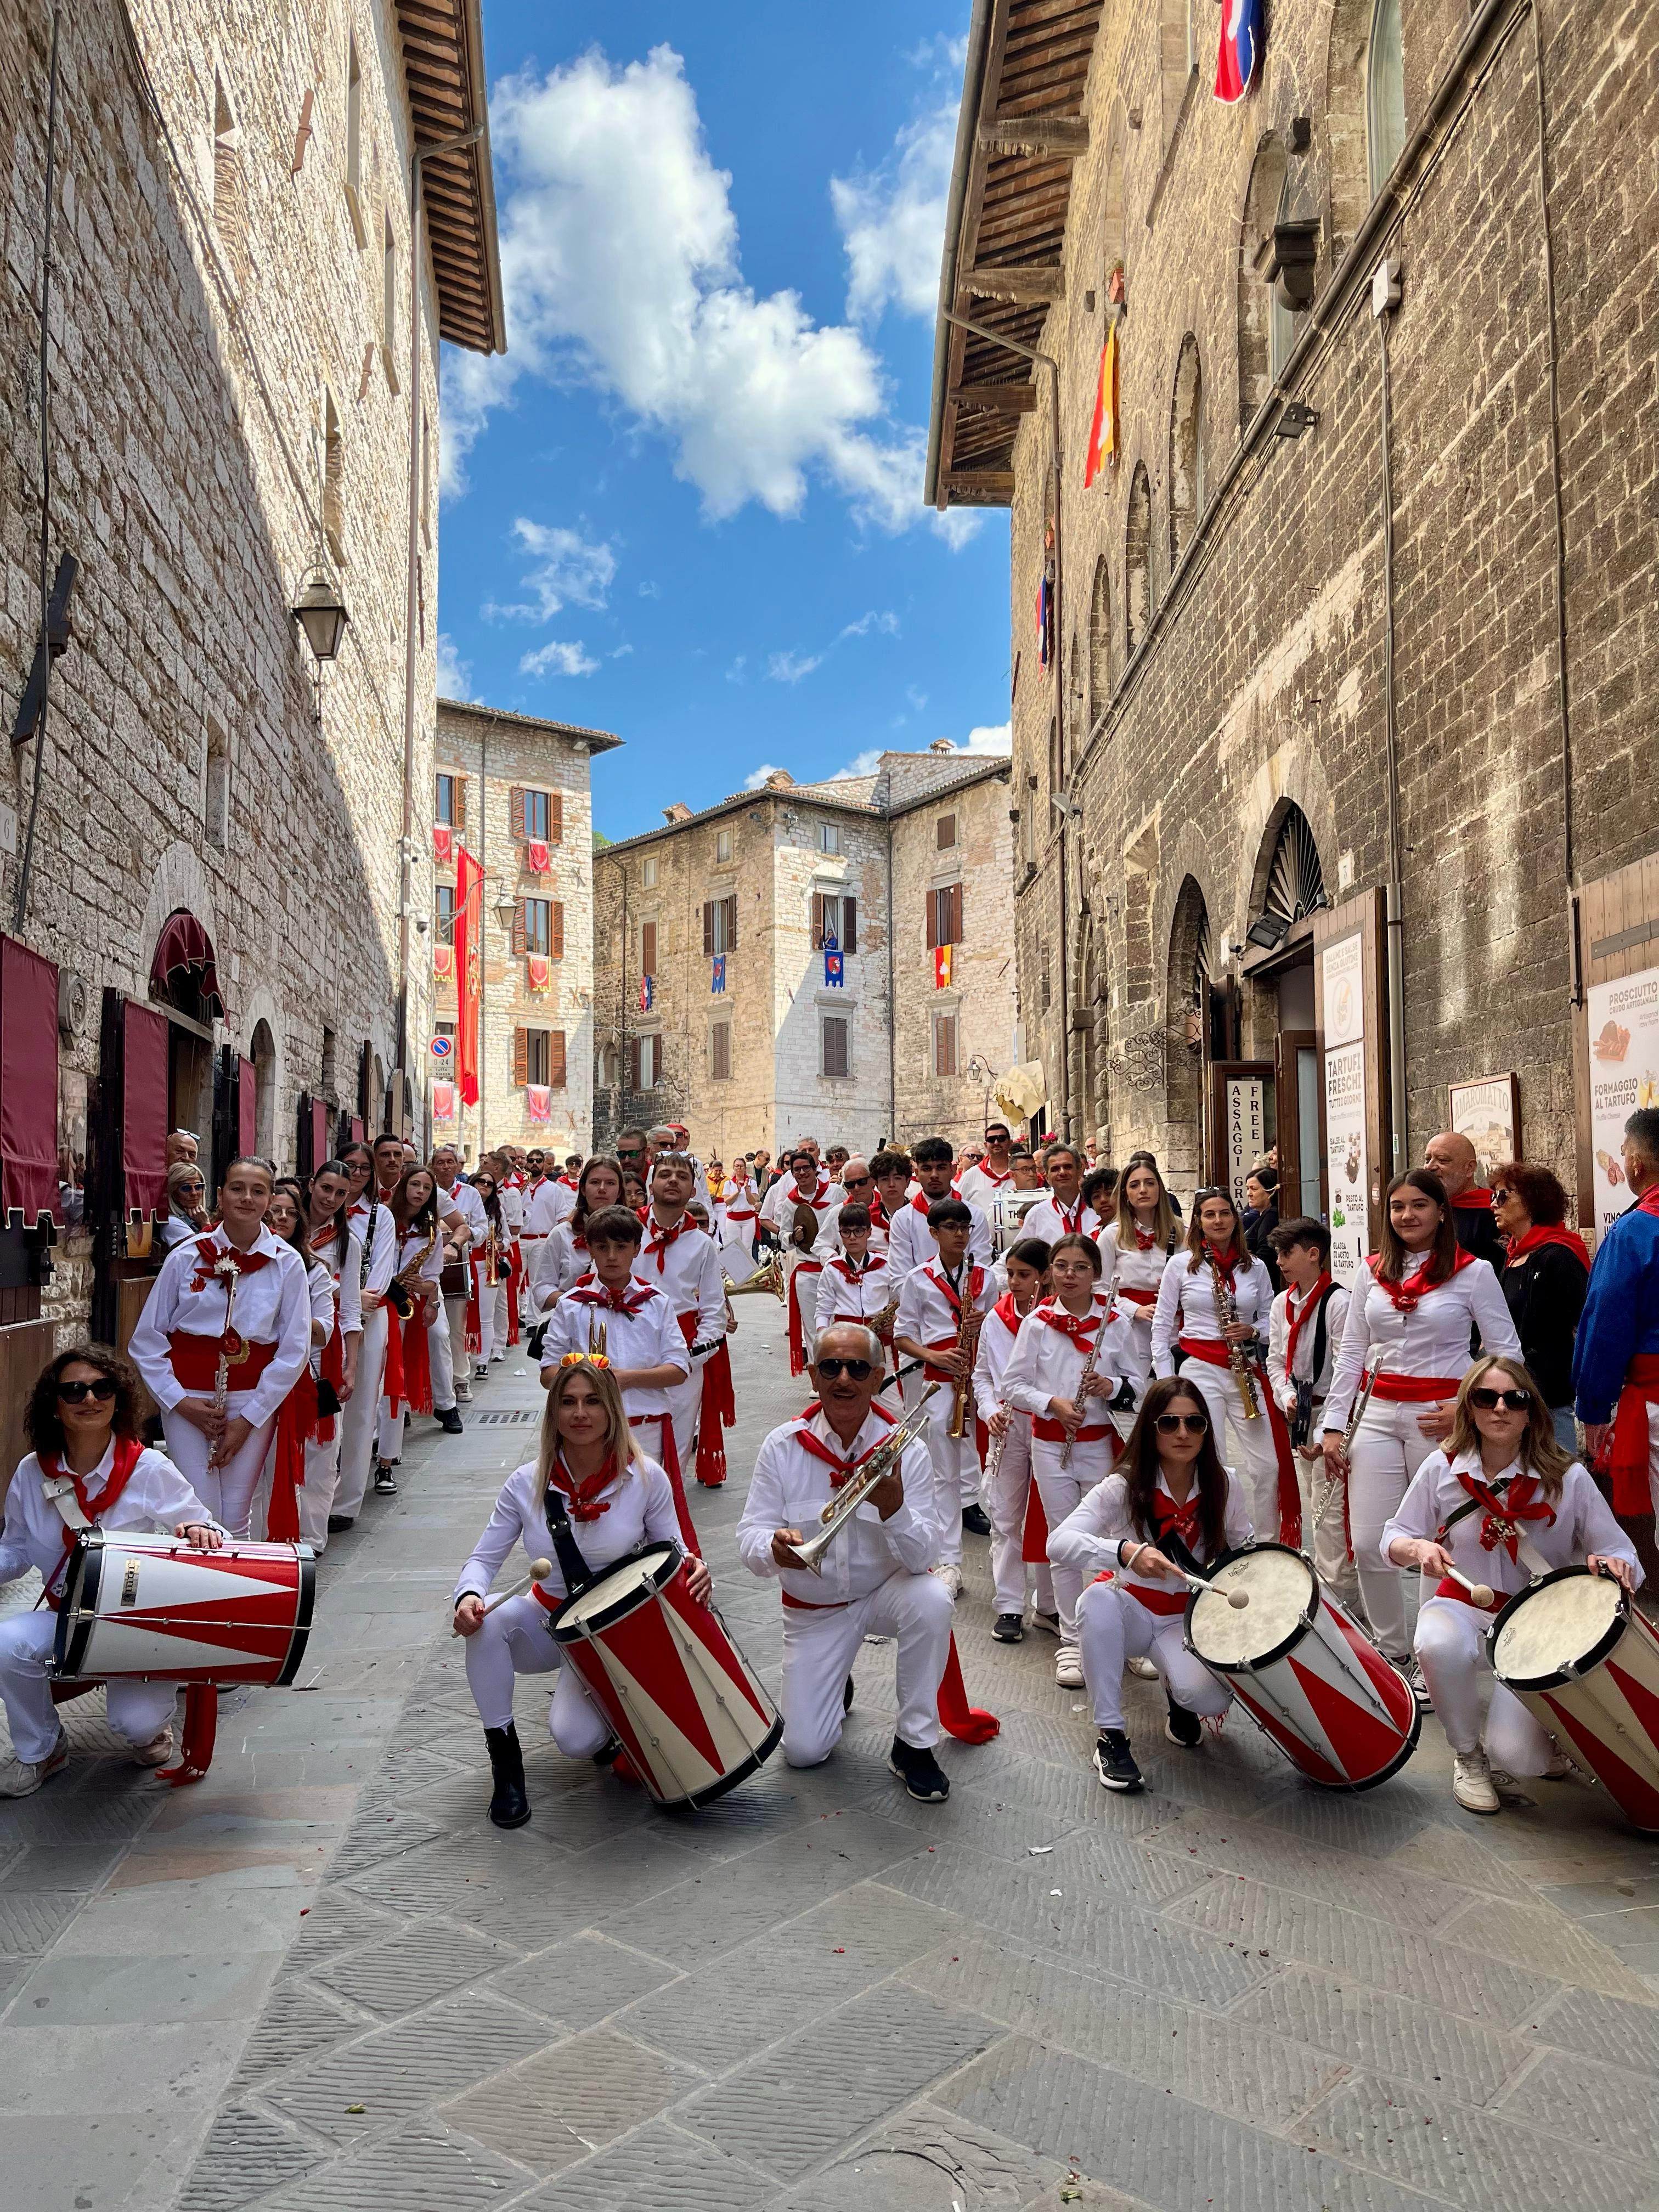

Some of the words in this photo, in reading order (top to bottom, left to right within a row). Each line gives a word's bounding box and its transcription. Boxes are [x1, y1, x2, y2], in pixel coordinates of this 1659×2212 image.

[4, 818, 9, 839] 6
[1609, 981, 1657, 1006] PROSCIUTTO
[1609, 1004, 1626, 1014] CRUDO
[1626, 994, 1658, 1010] ARTIGIANALE
[1328, 1052, 1361, 1078] TARTUFI
[1328, 1072, 1361, 1096] FRESCHI
[1594, 1077, 1638, 1097] FORMAGGIO
[1329, 1097, 1340, 1109] TUTTI
[1344, 1093, 1361, 1106] GIORNI
[1455, 1084, 1509, 1124] AMAROMATTO
[1595, 1098, 1604, 1110] AL
[1604, 1092, 1635, 1108] TARTUFO
[1250, 1086, 1260, 1140] FREE
[1232, 1085, 1243, 1167] ASSAGGI
[1330, 1136, 1340, 1145] SALSE
[1330, 1144, 1345, 1154] TARTUFO
[1346, 1194, 1358, 1203] PESTO
[1358, 1194, 1364, 1202] AL
[1347, 1203, 1364, 1212] TARTUFO
[1333, 1242, 1347, 1250] GLASSA
[1338, 1251, 1349, 1259] ACETO
[1338, 1260, 1354, 1268] TARTUFO
